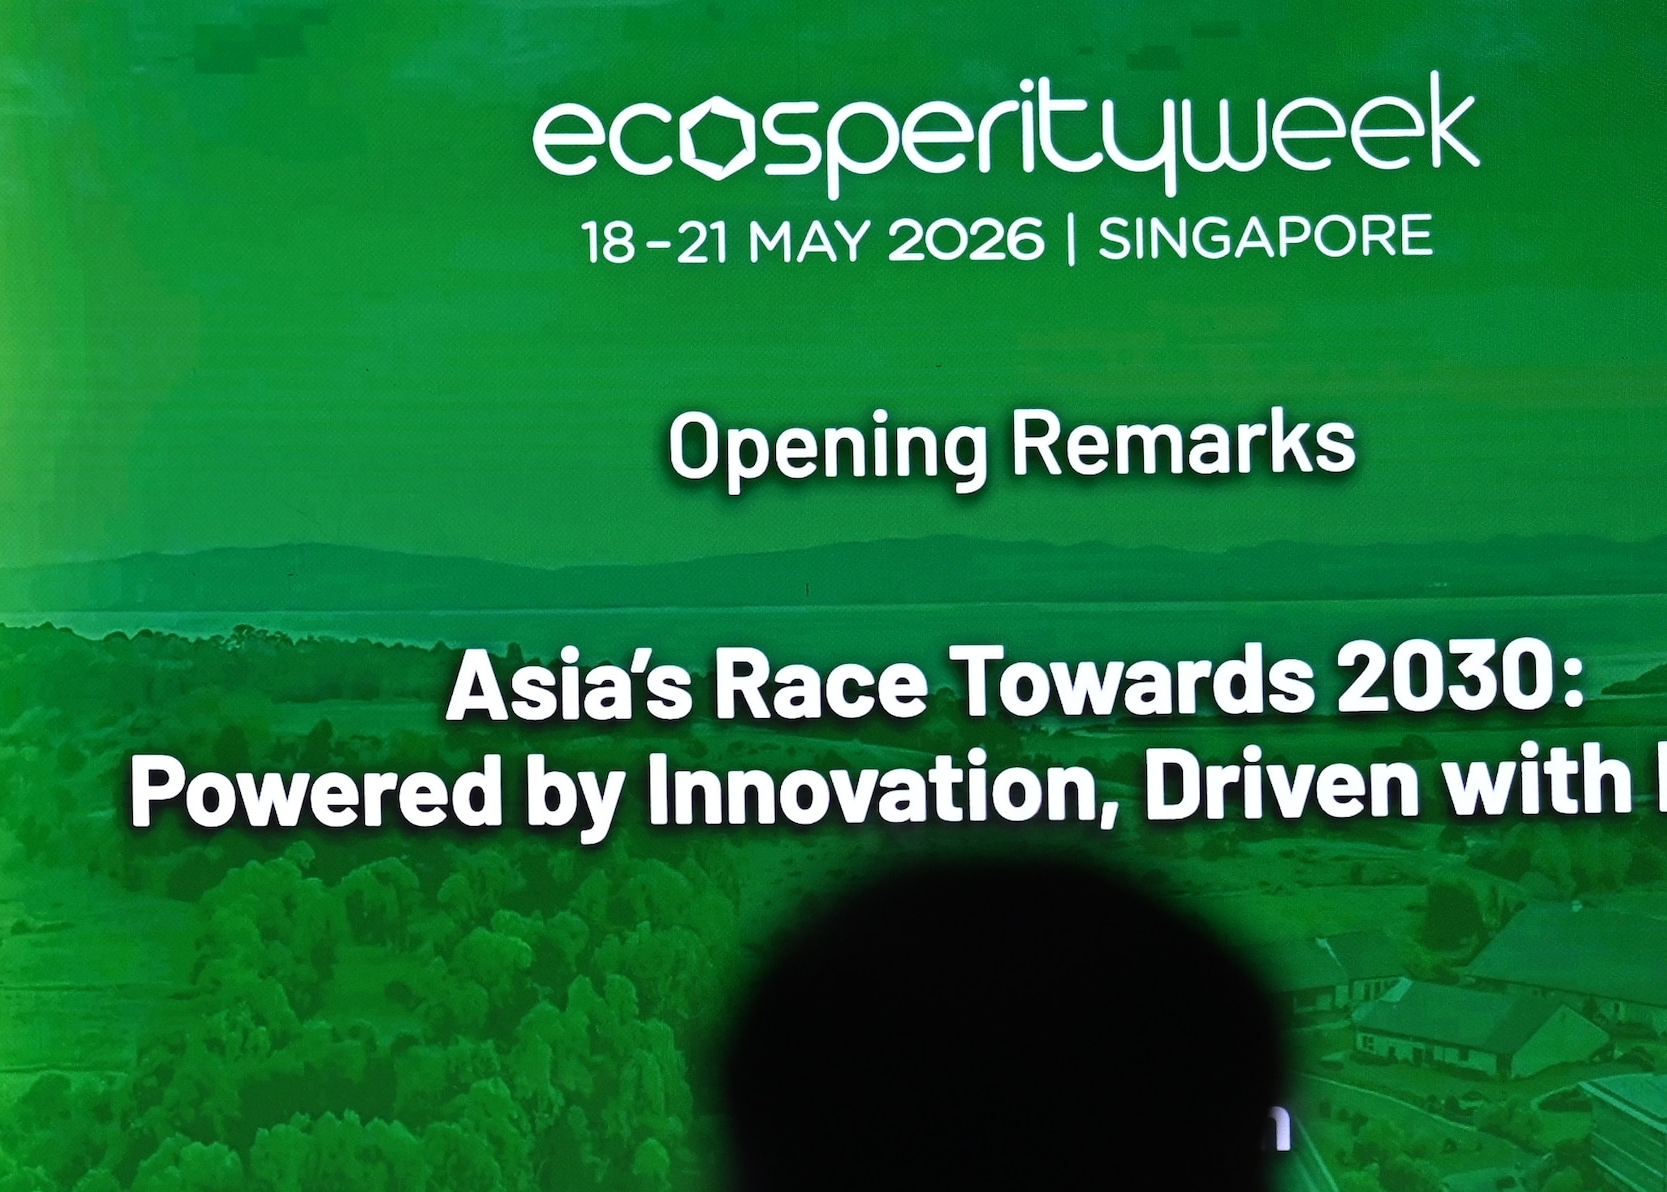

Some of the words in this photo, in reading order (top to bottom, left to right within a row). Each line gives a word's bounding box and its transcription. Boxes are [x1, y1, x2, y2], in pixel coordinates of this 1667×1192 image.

[750, 219, 871, 263] MAY
[888, 216, 1045, 261] 2026
[1099, 213, 1433, 260] SINGAPORE
[670, 408, 987, 496] Opening
[1013, 406, 1356, 475] Remarks
[716, 647, 928, 719] Race
[949, 642, 1315, 717] Towards
[1337, 637, 1584, 712] 2030:
[131, 753, 502, 828] Powered
[527, 753, 622, 845] by
[649, 747, 1119, 830] Innovation,
[1146, 744, 1419, 820] Driven
[1441, 740, 1632, 816] with
